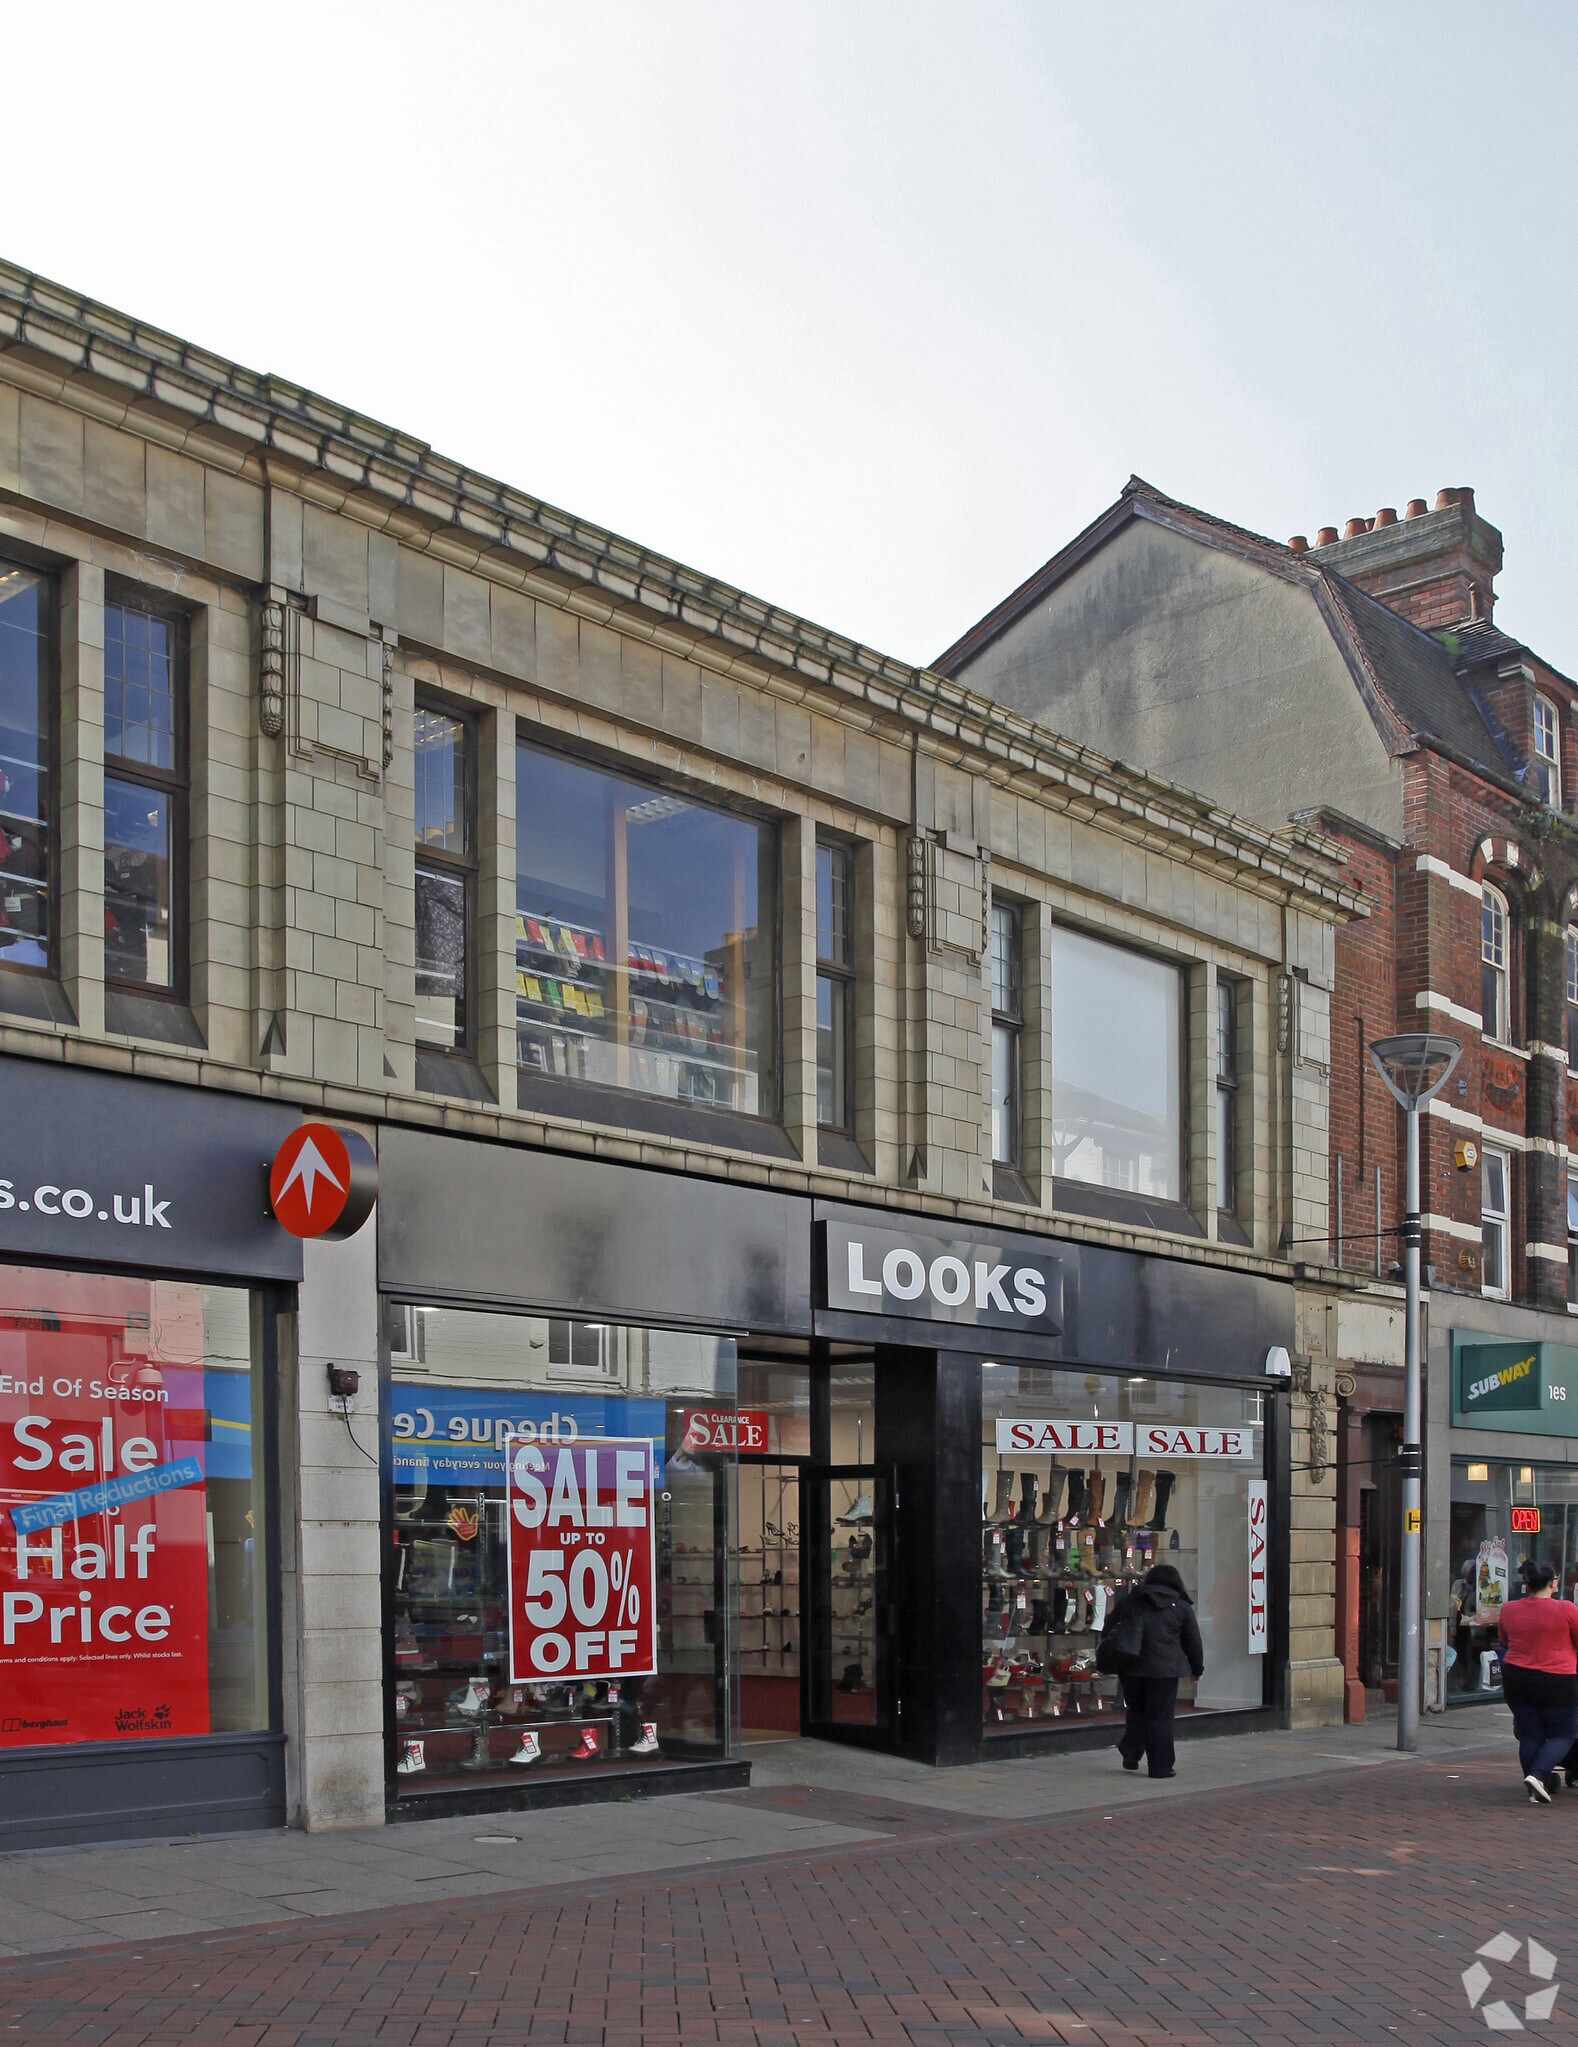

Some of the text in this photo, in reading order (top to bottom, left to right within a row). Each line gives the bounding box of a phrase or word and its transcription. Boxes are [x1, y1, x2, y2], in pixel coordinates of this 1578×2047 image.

[847, 1241, 1047, 1317] LOOKS
[0, 1375, 169, 1403] End Of Season
[1467, 1353, 1537, 1401] SUBWAY
[12, 1414, 158, 1473] Sale
[1011, 1424, 1121, 1450] SALE
[1148, 1429, 1242, 1455] SALE
[78, 1465, 195, 1512] Reductions
[512, 1444, 647, 1529] SALE
[560, 1532, 606, 1546] UP TO
[1511, 1509, 1538, 1531] OPEN
[16, 1523, 157, 1581] Half
[1249, 1496, 1266, 1638] SALE
[523, 1548, 640, 1629] 50%
[530, 1629, 639, 1673] OFF
[22, 1718, 69, 1729] berghaus
[114, 1708, 146, 1721] Jack
[114, 1718, 172, 1732] Wolfskin
